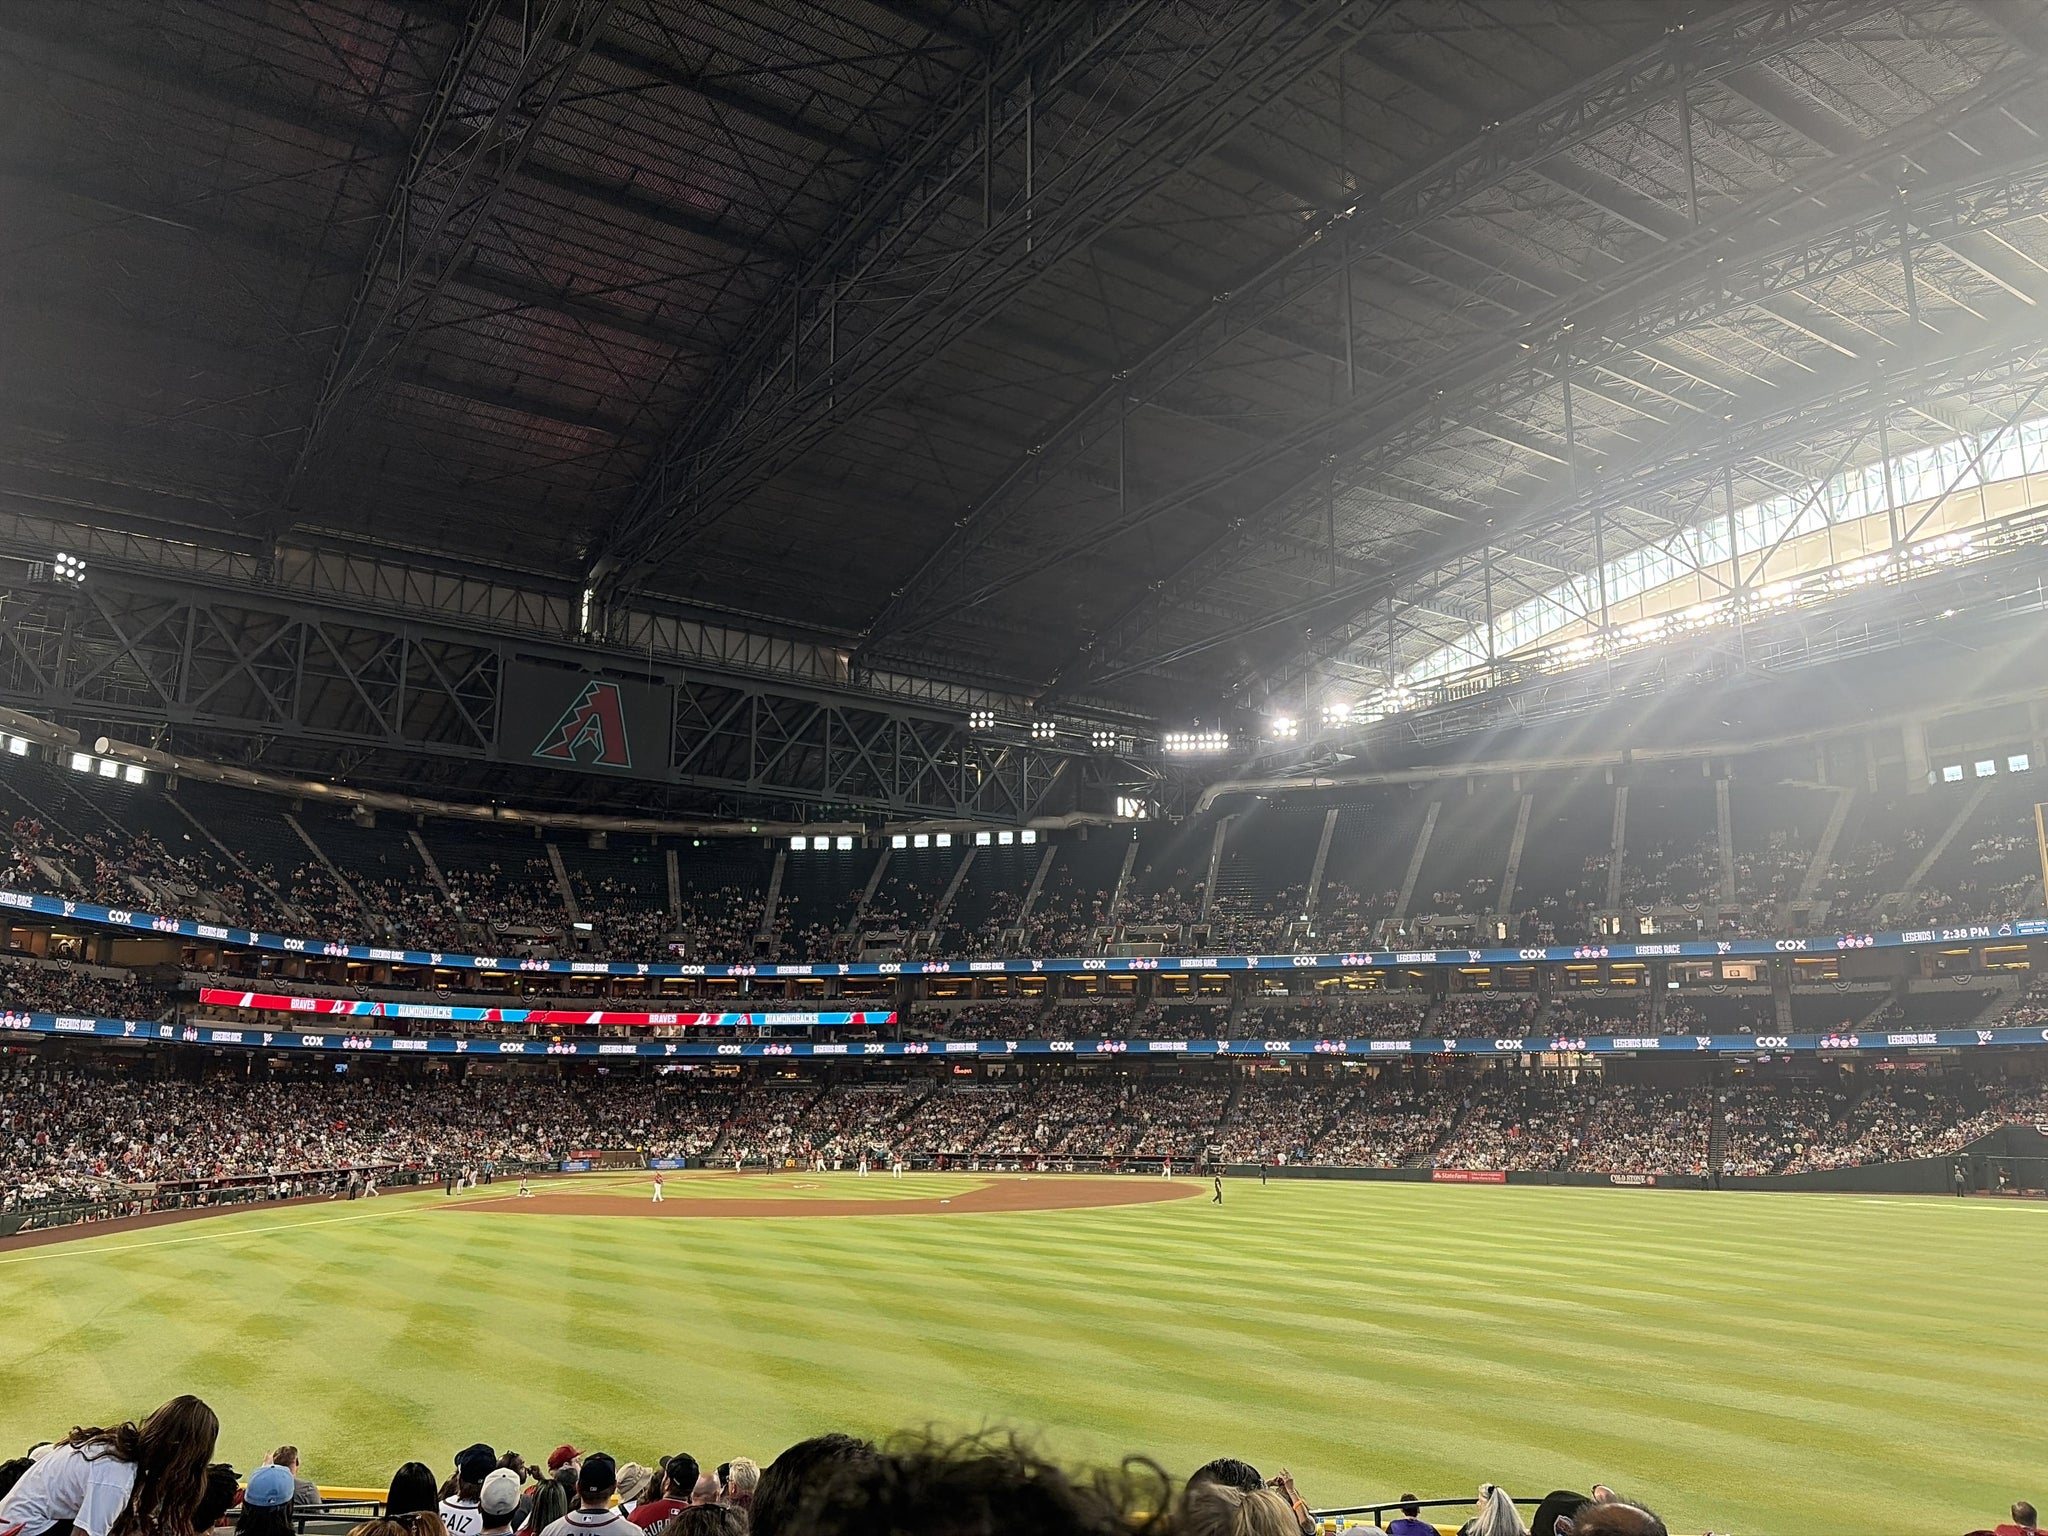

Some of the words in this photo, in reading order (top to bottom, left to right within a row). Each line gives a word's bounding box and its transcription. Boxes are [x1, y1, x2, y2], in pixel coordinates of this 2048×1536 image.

[109, 910, 131, 925] COX
[1902, 931, 1930, 942] LEGENDS
[1943, 929, 1967, 939] 2:38
[1970, 927, 1990, 937] PM
[284, 939, 304, 950] COX
[1776, 940, 1806, 950] COX
[1520, 949, 1546, 959] COX
[1636, 945, 1662, 954] LEGENDS
[1664, 945, 1680, 953] RACE
[475, 957, 497, 967] COX
[1293, 957, 1317, 966] COX
[1397, 954, 1420, 962] LEGENDS
[1422, 953, 1436, 961] RACE
[879, 964, 900, 972] COX
[1083, 960, 1105, 969] COX
[682, 965, 704, 974] COX
[291, 999, 315, 1009] BRAVES
[398, 1006, 452, 1017] DIAMONDBACKS
[649, 1014, 676, 1023] BRAVES
[765, 1014, 818, 1023] DIAMONDBACKS
[160, 1026, 173, 1036] COX
[303, 1036, 323, 1046] COX
[1613, 1039, 1641, 1048] LEGENDS
[1643, 1039, 1659, 1047] RACE
[1756, 1037, 1788, 1047] COX
[1888, 1035, 1917, 1044] LEGENDS
[1919, 1034, 1937, 1043] RACE
[500, 1043, 524, 1052] COX
[1050, 1042, 1073, 1051] COX
[1265, 1042, 1290, 1051] COX
[1396, 1041, 1410, 1050] RACE
[1495, 1040, 1522, 1049] COX
[718, 1045, 741, 1054] COX
[1611, 1174, 1626, 1182] COLD
[1626, 1175, 1646, 1183] STONE
